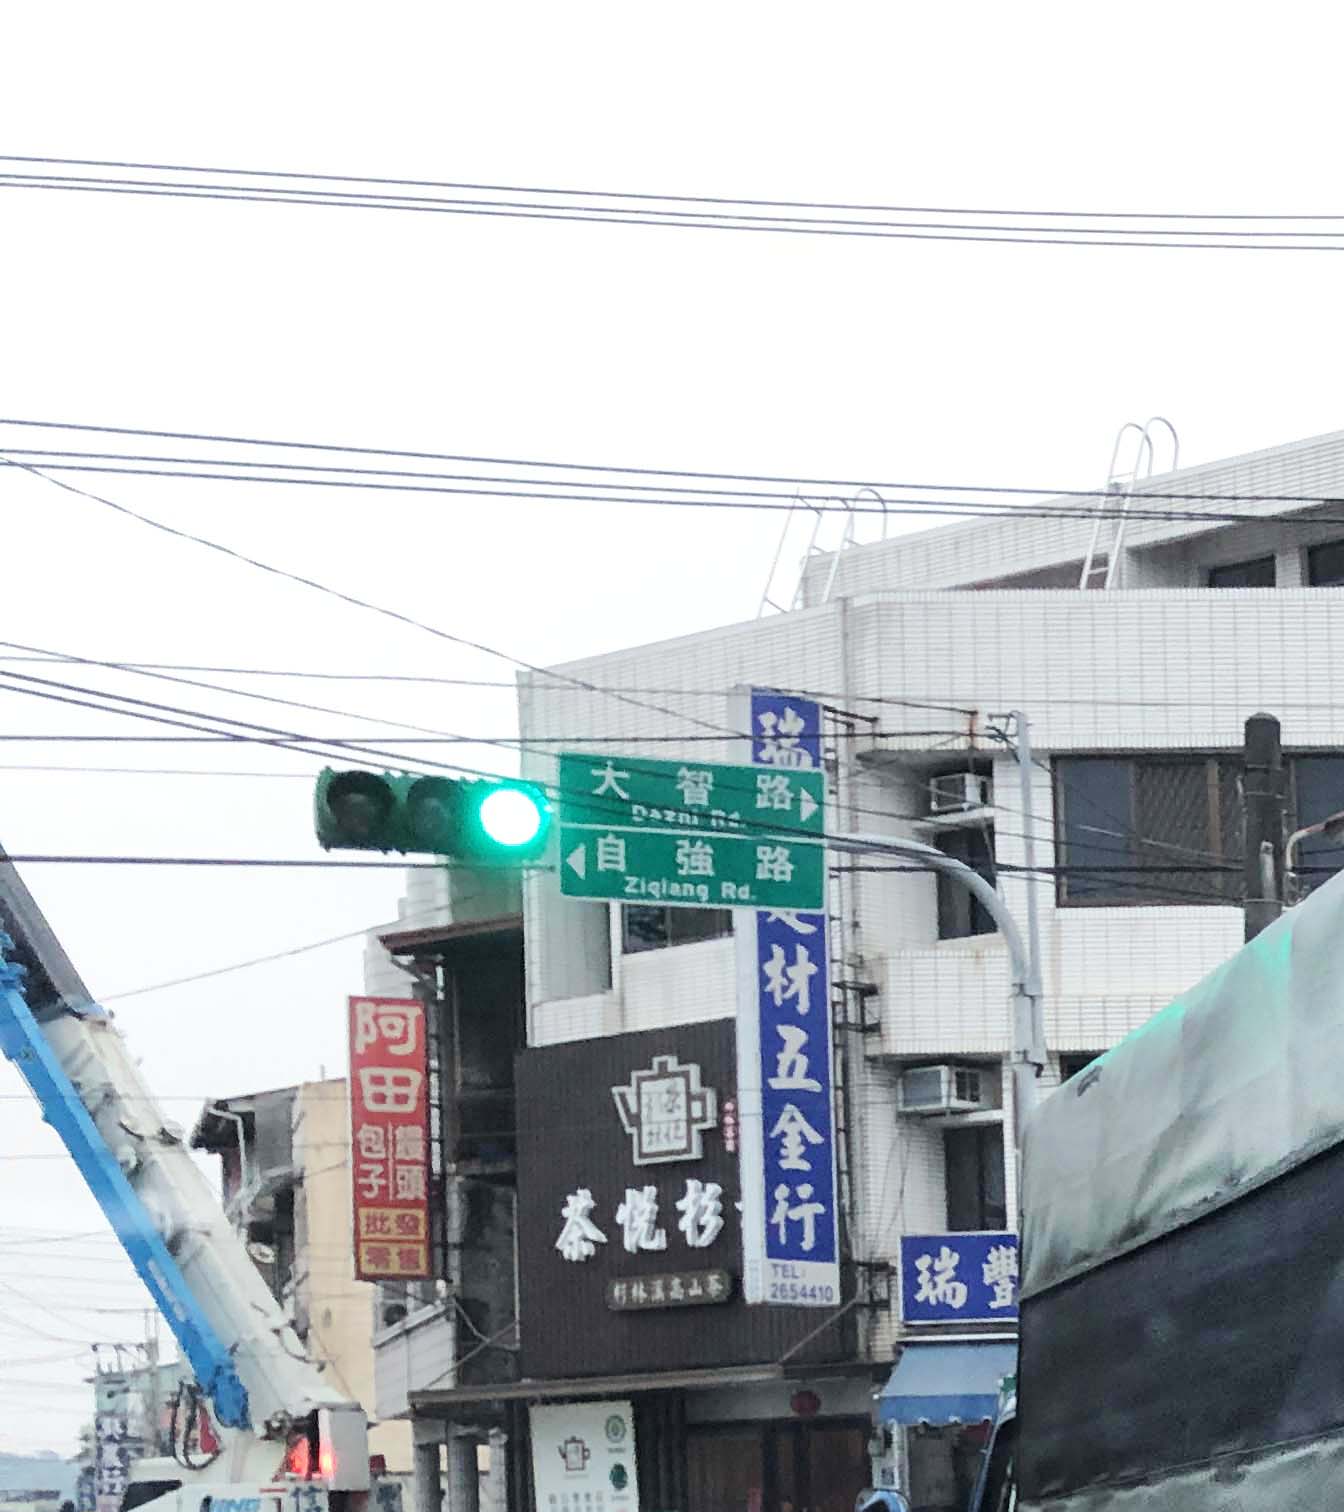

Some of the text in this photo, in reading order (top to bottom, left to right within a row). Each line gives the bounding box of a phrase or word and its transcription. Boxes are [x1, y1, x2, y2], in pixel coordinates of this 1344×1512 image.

[591, 760, 795, 811] 大智路
[597, 832, 795, 882] 自強路
[624, 876, 757, 902] Ziqiang Rd.
[355, 1001, 423, 1113] 阿田
[356, 1123, 387, 1199] 包子
[770, 1283, 834, 1301] 2654410
